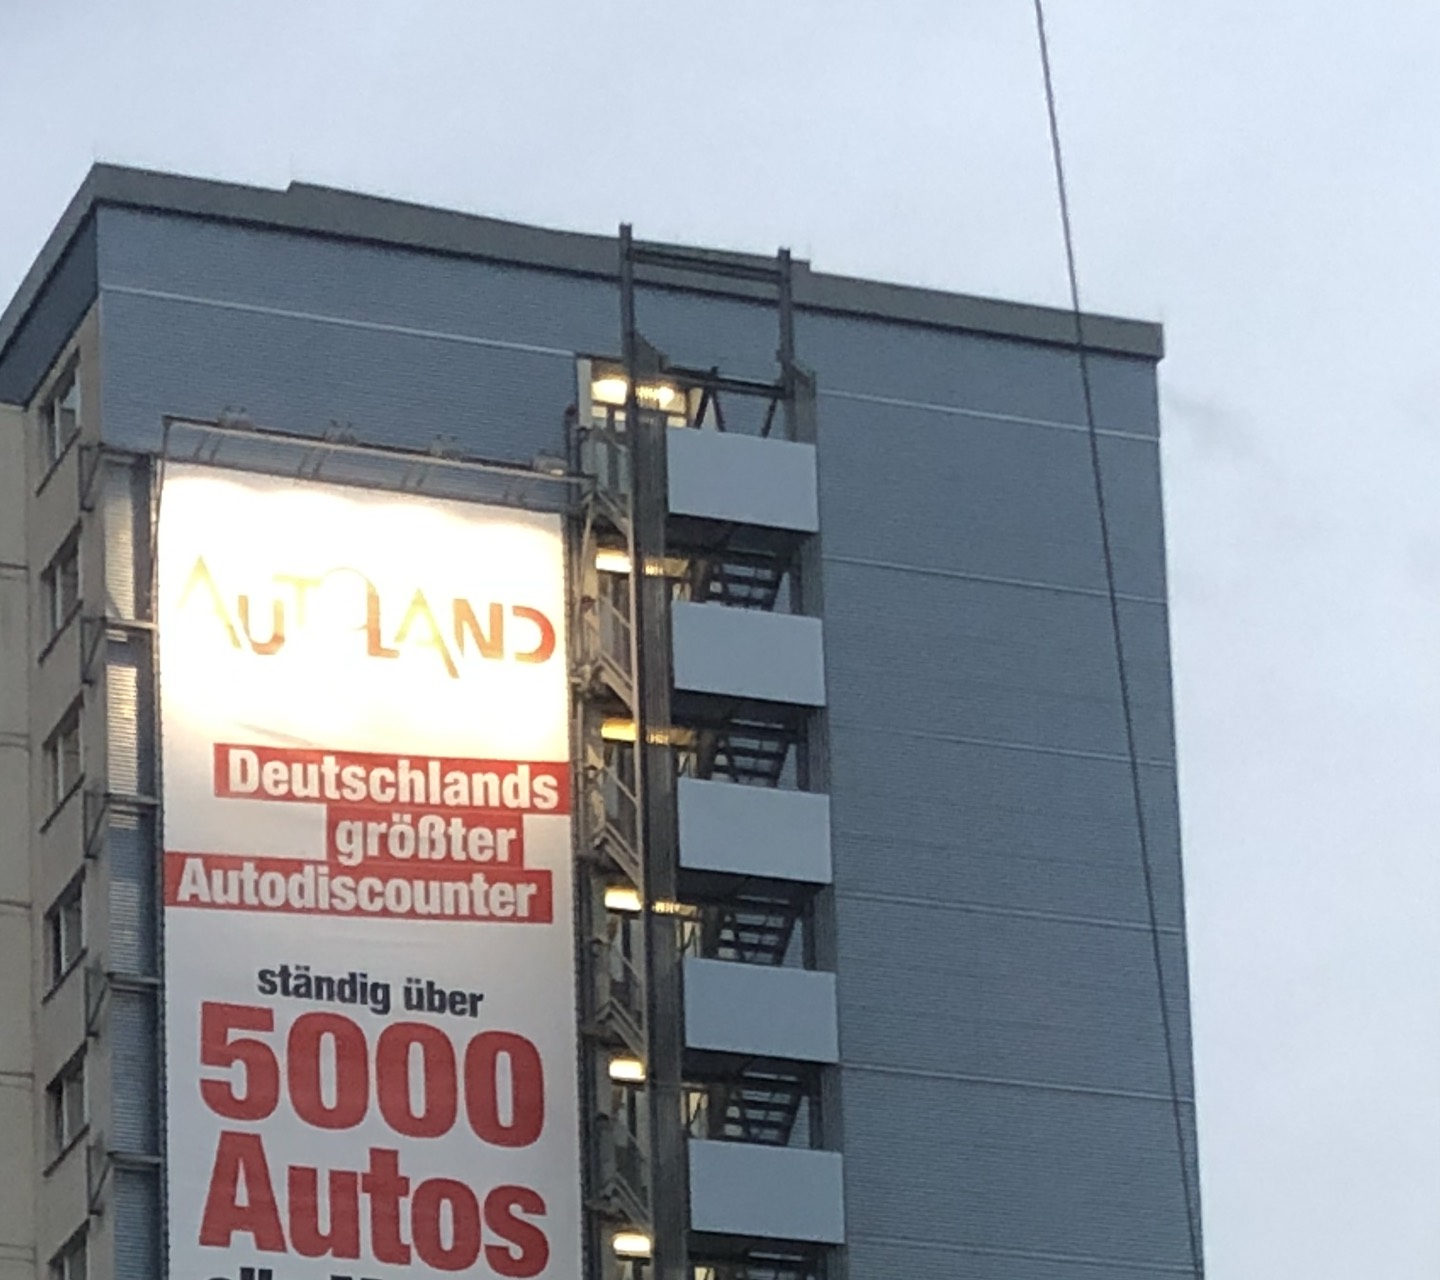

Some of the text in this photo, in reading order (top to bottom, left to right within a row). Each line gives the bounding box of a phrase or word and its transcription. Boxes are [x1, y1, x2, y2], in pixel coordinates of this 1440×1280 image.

[178, 554, 557, 679] AUTOLAND
[227, 748, 559, 809] Deutschlands
[335, 813, 516, 866] größter
[178, 857, 537, 918] Autodiscounter
[258, 964, 484, 1018] ständig über
[199, 1000, 545, 1148] 5000
[198, 1130, 550, 1279] Autos
